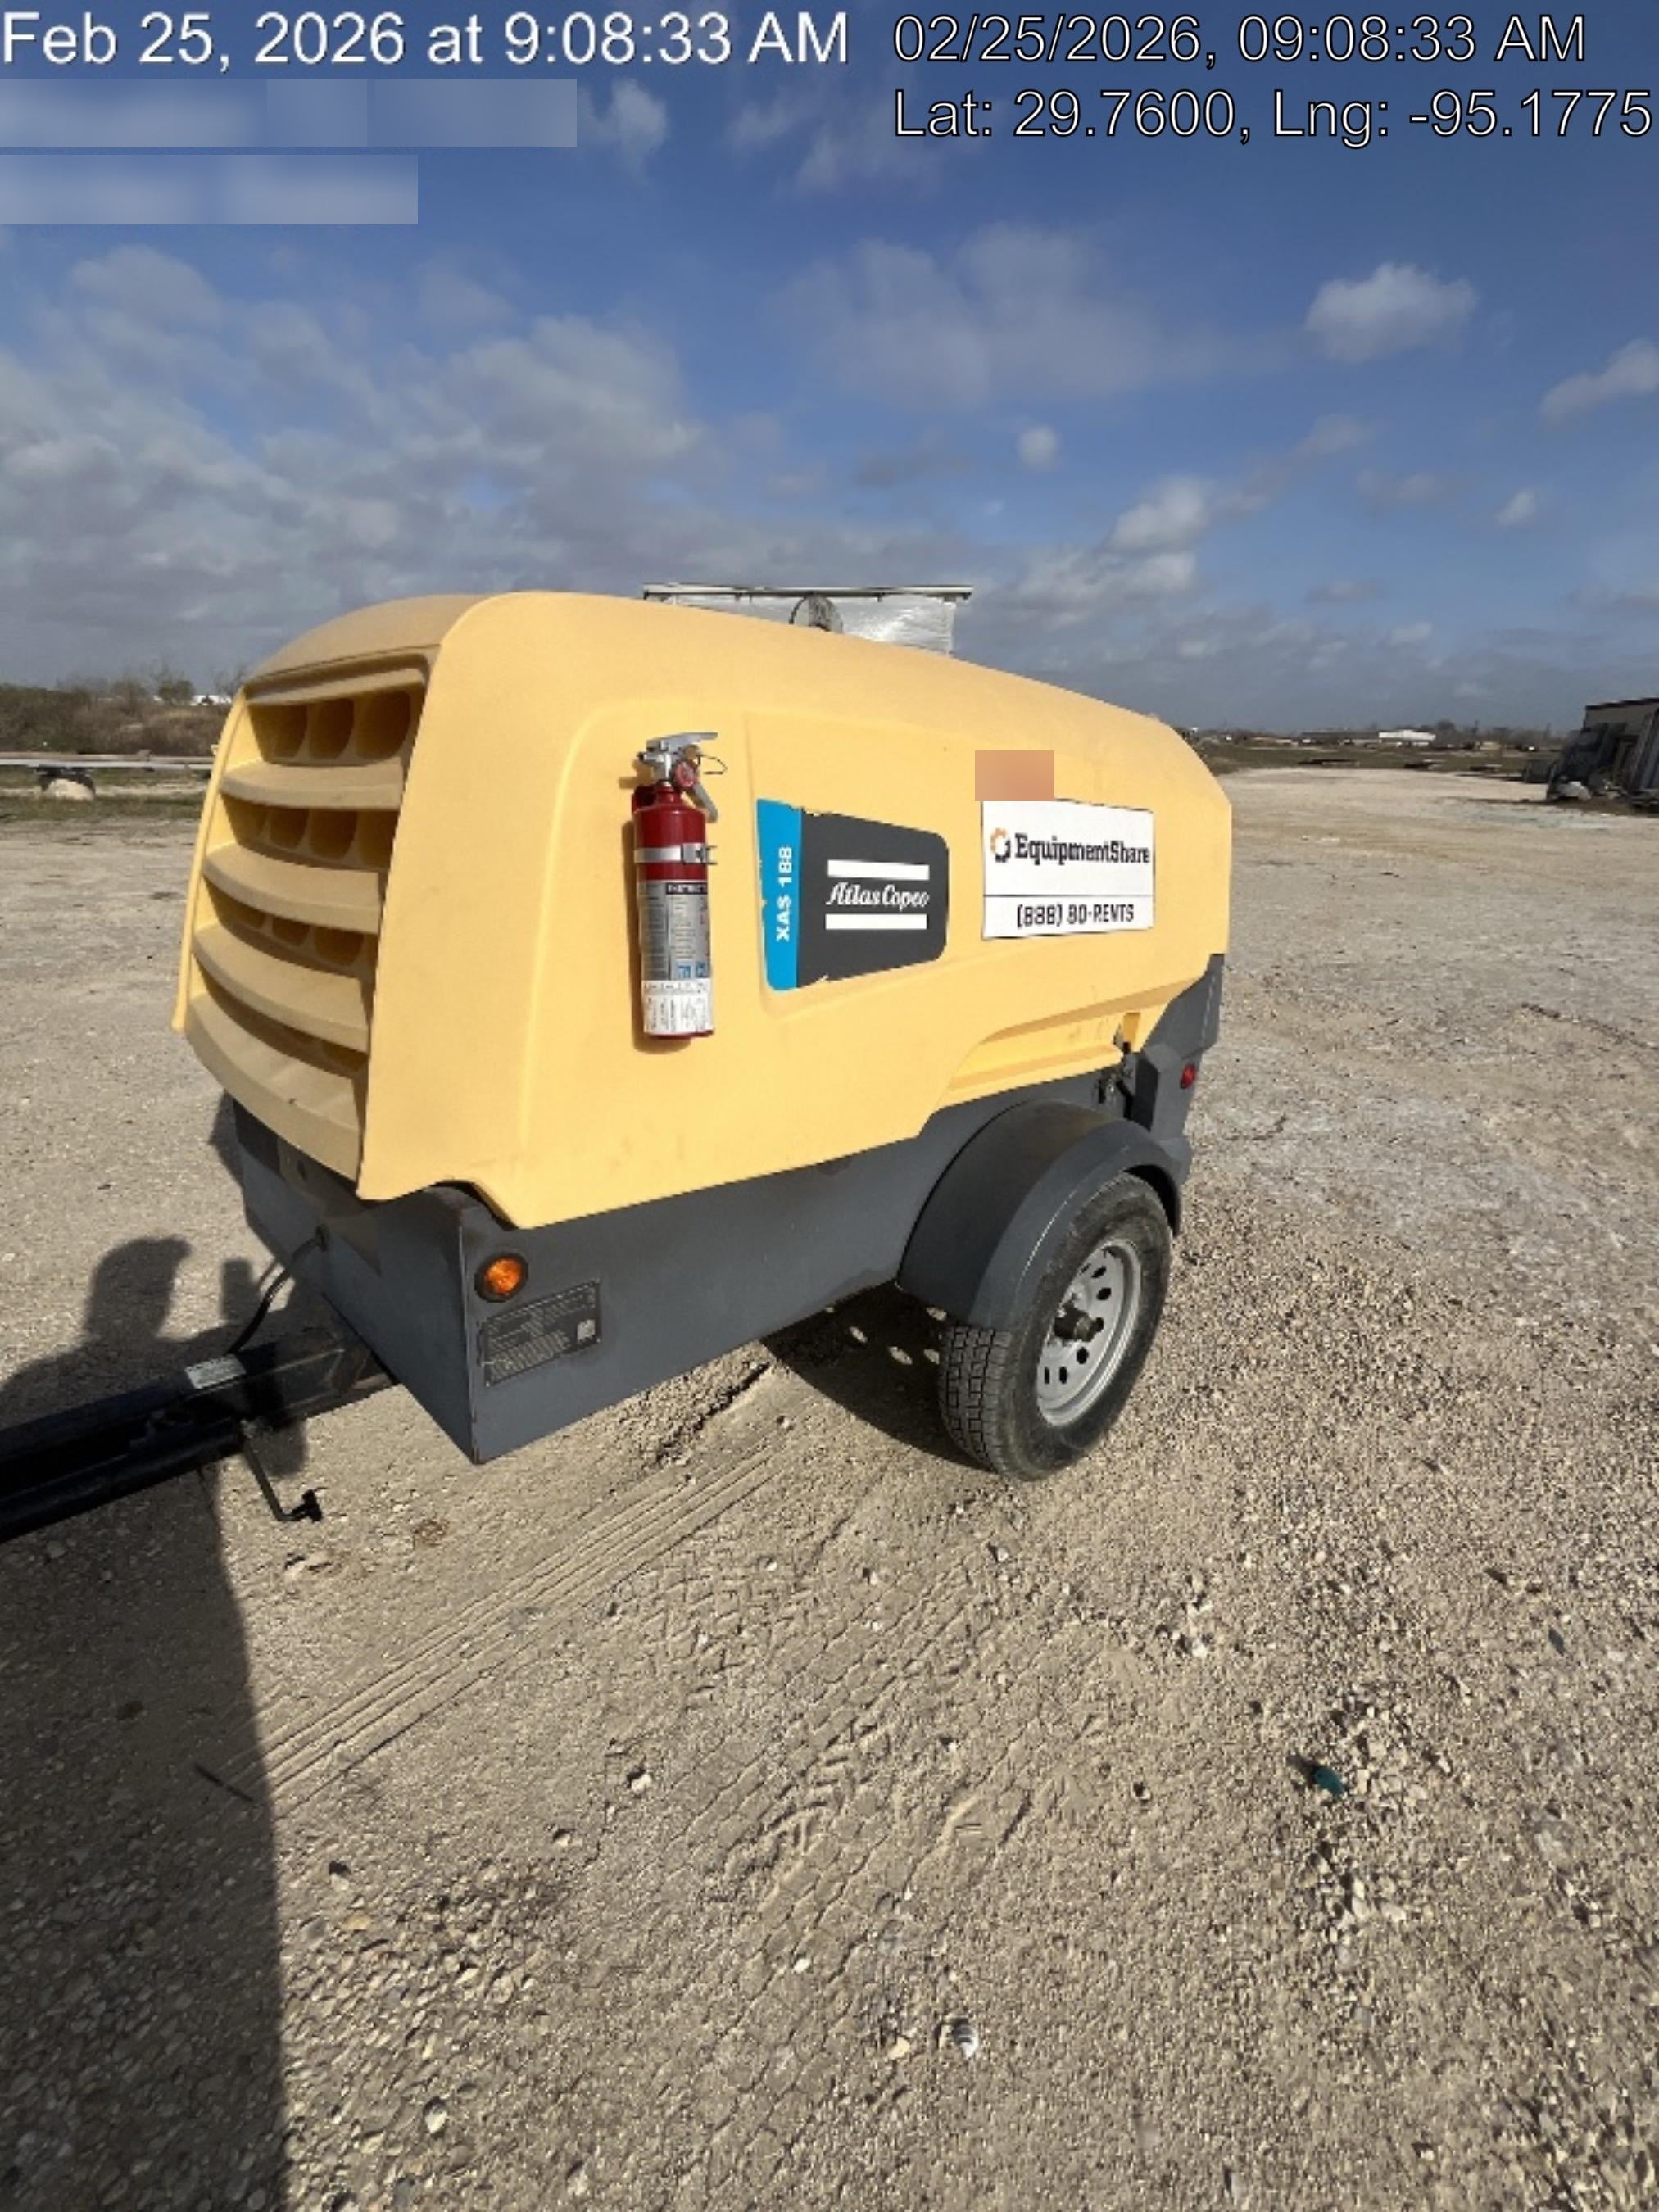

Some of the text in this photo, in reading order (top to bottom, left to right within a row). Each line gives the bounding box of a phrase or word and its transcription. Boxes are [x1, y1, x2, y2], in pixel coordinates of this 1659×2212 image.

[1014, 832, 1149, 866] EquipmentShare
[776, 846, 792, 942] XAS 188
[825, 882, 930, 912] Atlas Copco
